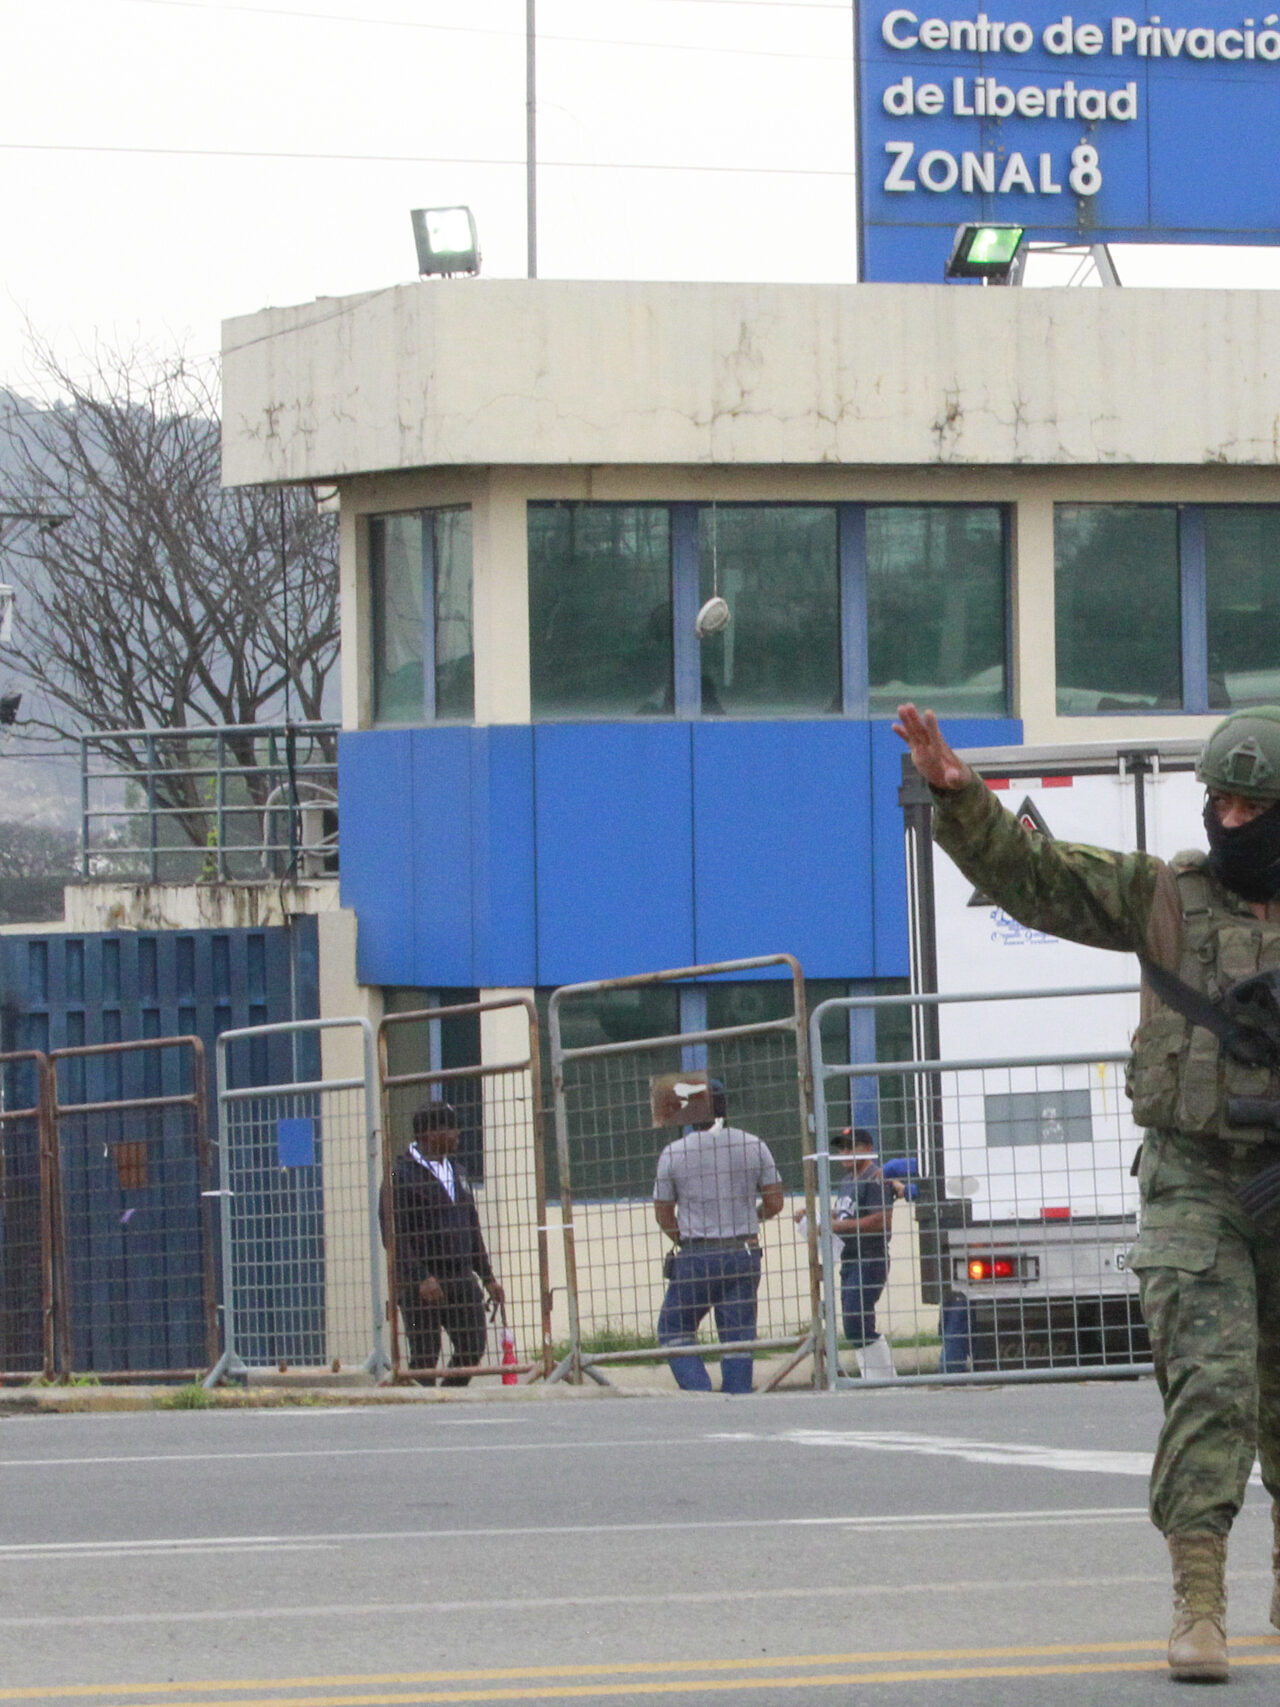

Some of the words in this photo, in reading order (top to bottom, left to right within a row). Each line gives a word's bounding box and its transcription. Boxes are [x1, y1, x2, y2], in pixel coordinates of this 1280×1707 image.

[882, 8, 1034, 54] Centro
[1043, 15, 1104, 55] de
[883, 76, 945, 116] de
[953, 76, 1138, 120] Libertad
[884, 140, 1063, 194] ZONAL
[1069, 144, 1103, 196] 8
